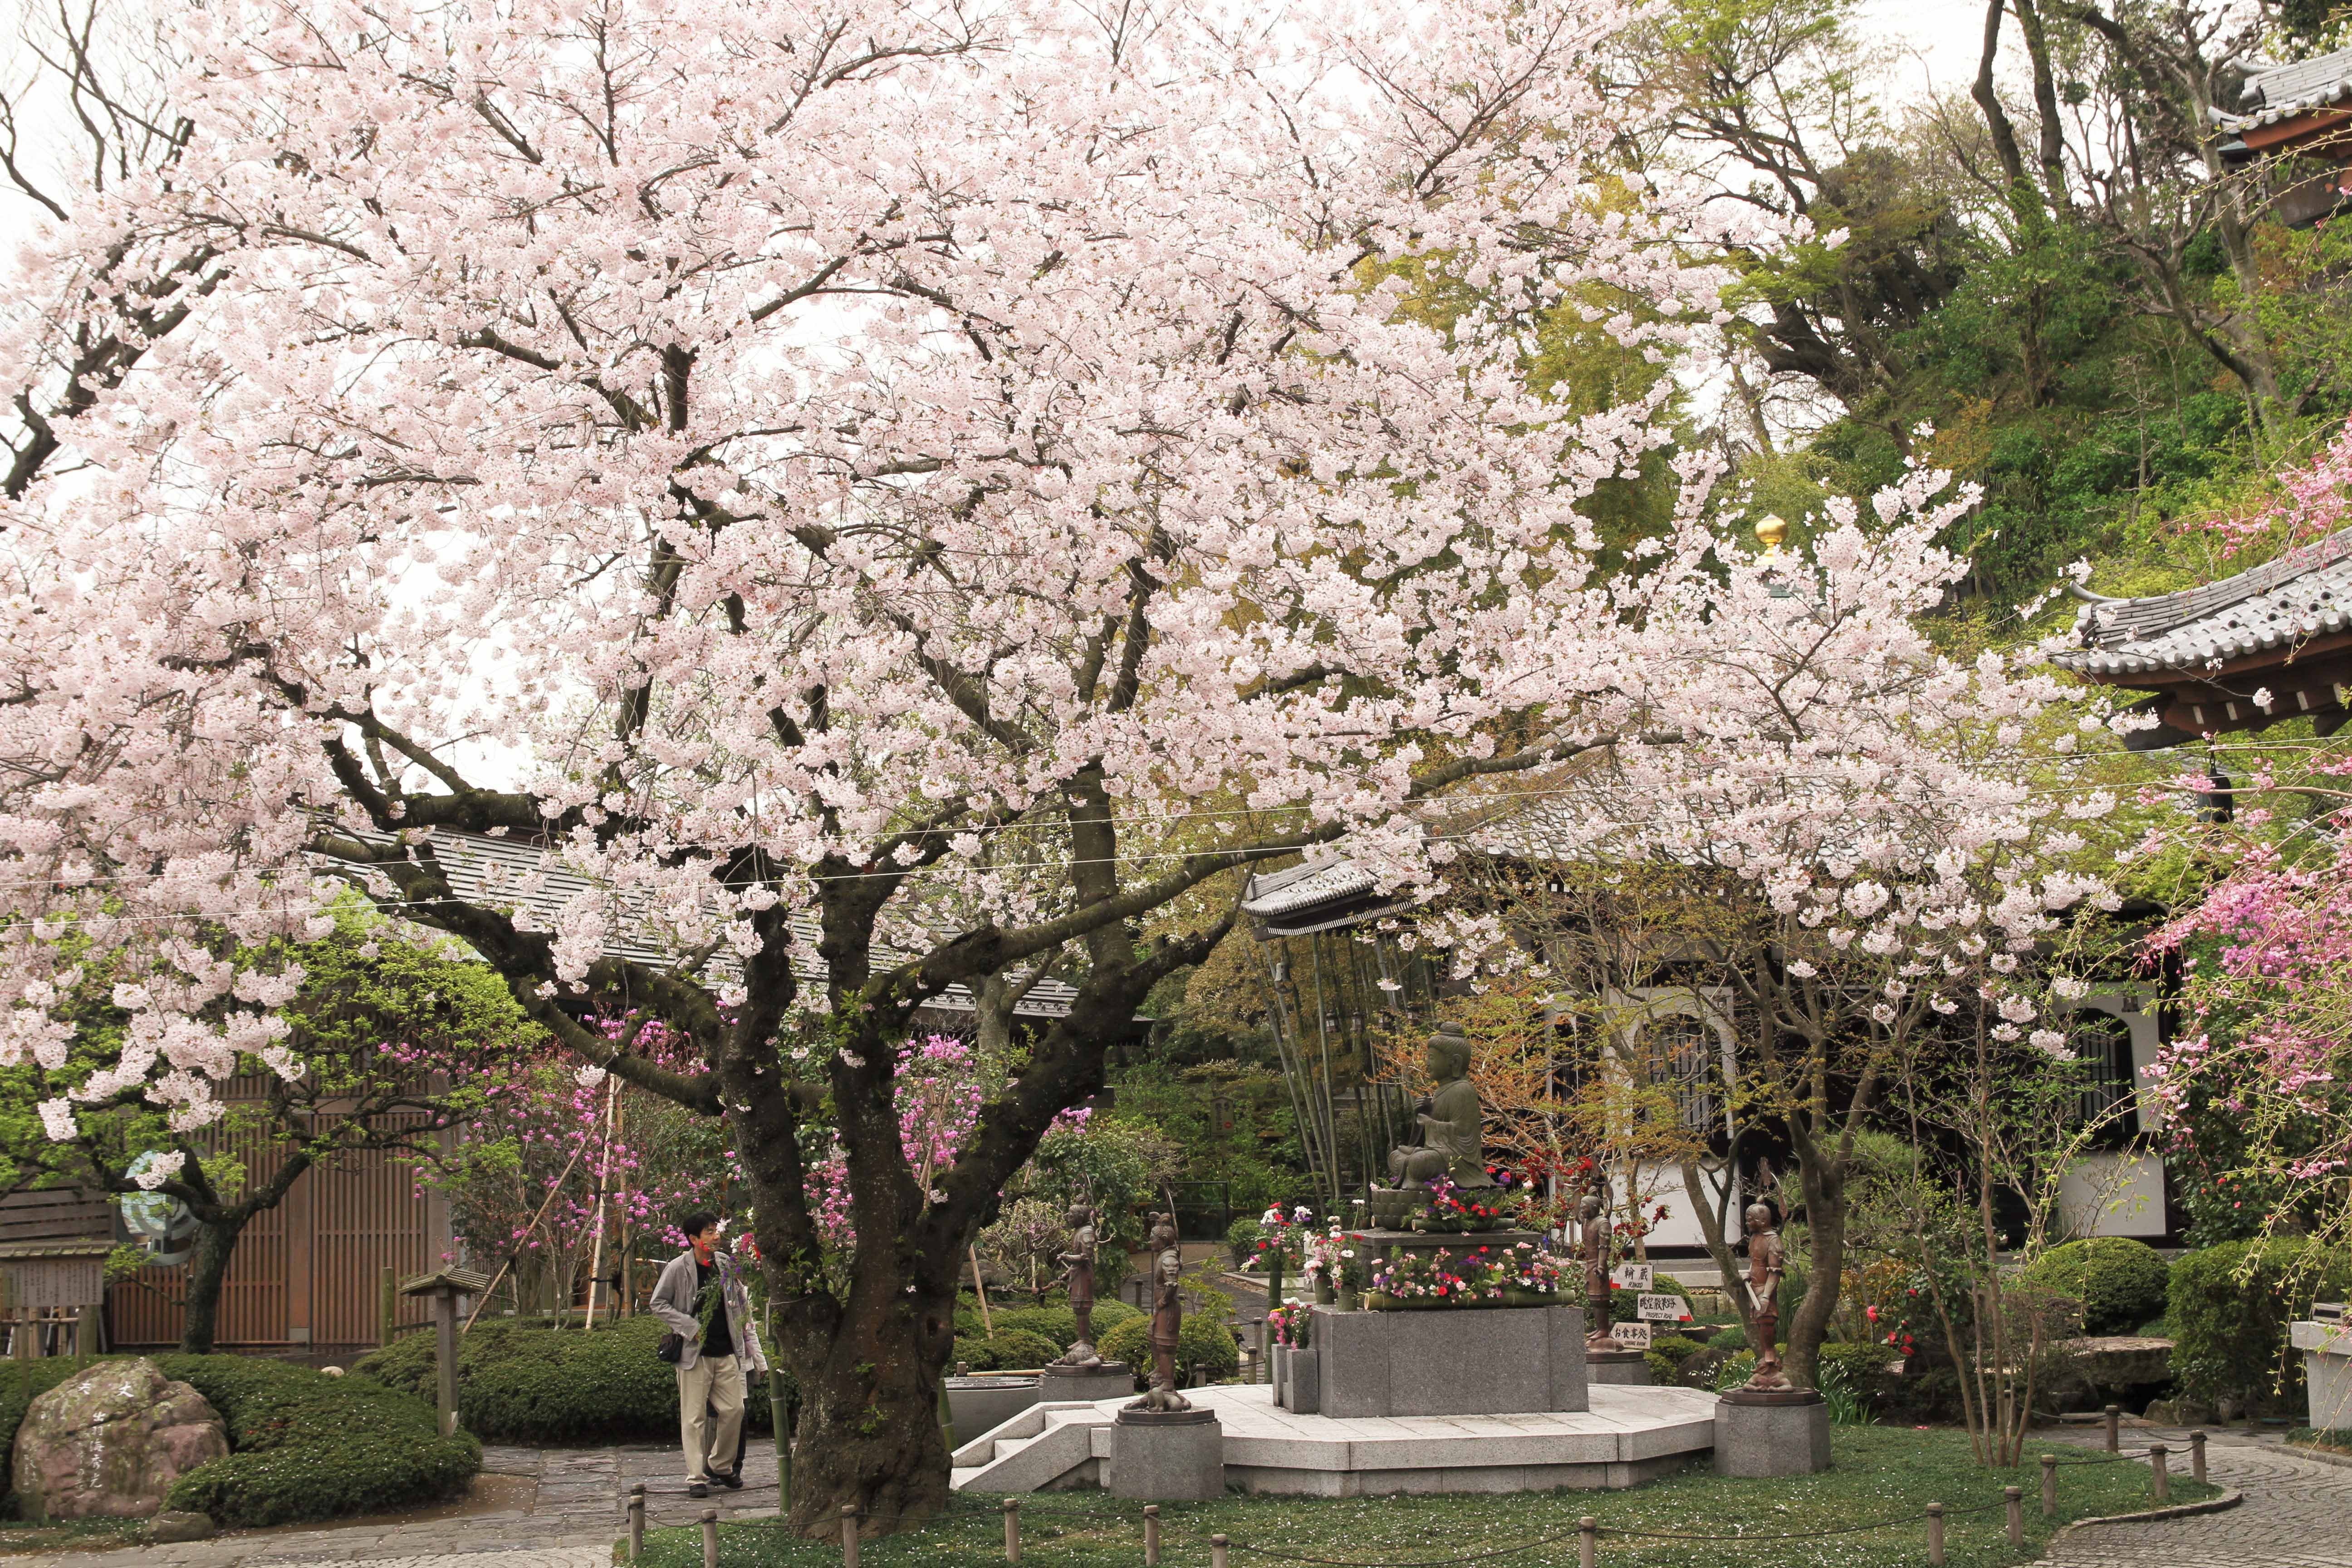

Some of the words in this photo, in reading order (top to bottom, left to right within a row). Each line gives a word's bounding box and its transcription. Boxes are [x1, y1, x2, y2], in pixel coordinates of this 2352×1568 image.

[1625, 1266, 1648, 1281] 輪蔵
[1640, 1296, 1676, 1310] 眺望散策路
[1615, 1327, 1647, 1339] お食事処
